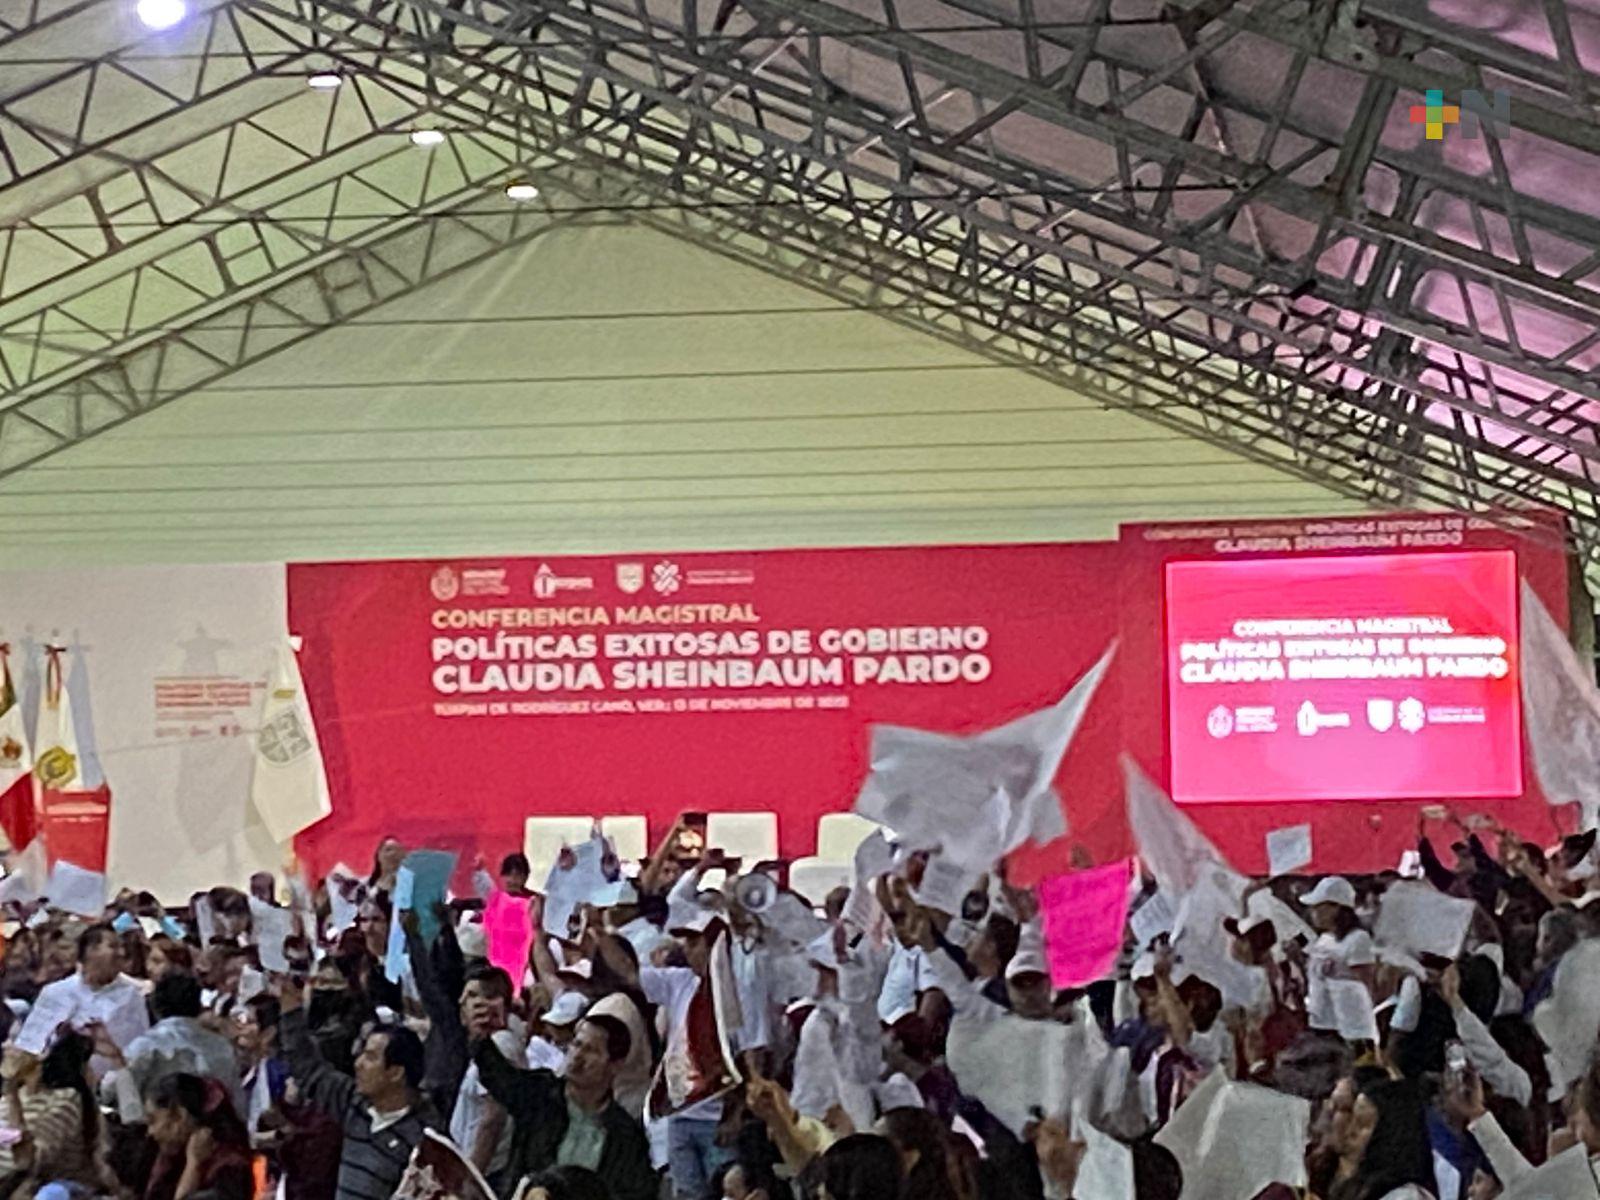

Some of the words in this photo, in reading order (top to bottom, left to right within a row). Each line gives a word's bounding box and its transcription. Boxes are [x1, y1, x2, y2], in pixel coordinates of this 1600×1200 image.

[431, 605, 611, 630] CONFERENCIA
[615, 603, 760, 625] MAGISTRAL
[432, 630, 597, 662] POLÍTICAS
[604, 631, 760, 658] EXITOSAS
[767, 629, 812, 654] DE
[819, 626, 989, 653] GOBIERNO
[432, 662, 605, 693] CLAUDIA
[612, 657, 843, 690] SHEINBAUM
[853, 653, 991, 685] PARDO
